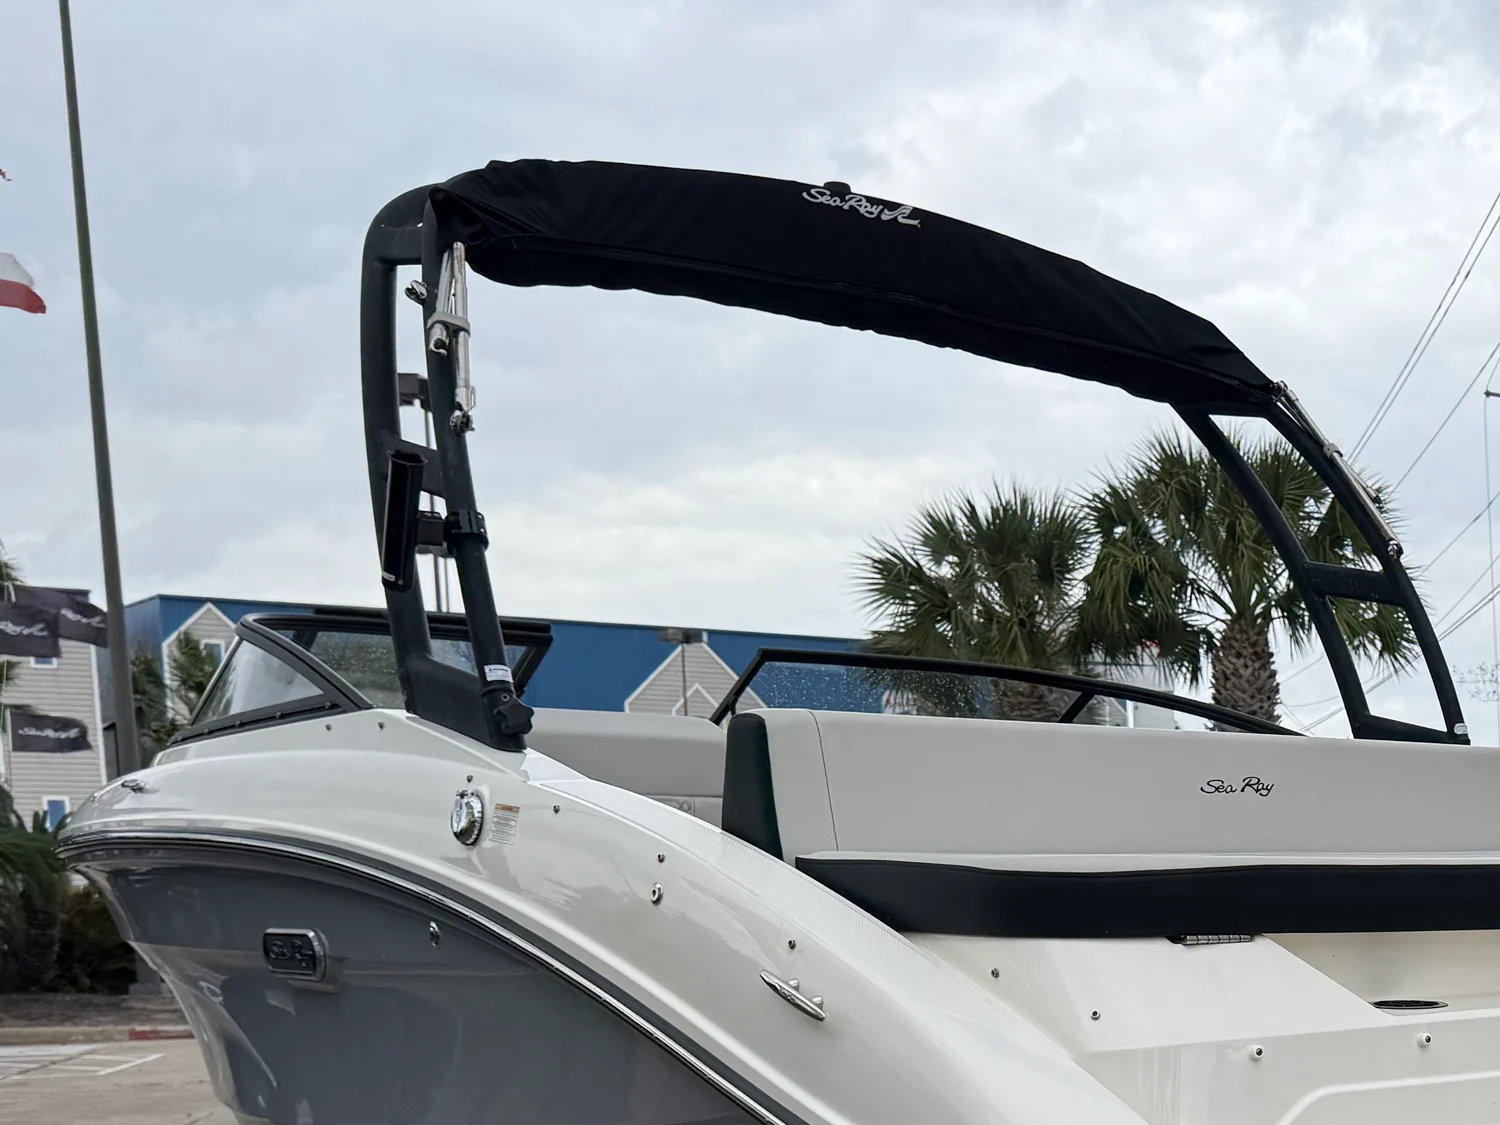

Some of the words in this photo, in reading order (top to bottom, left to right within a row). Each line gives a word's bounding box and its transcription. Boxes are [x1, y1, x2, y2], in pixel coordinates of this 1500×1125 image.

[802, 188, 844, 207] Sea
[843, 193, 884, 219] Ray
[1200, 779, 1237, 795] Sea
[1240, 776, 1275, 797] Ray
